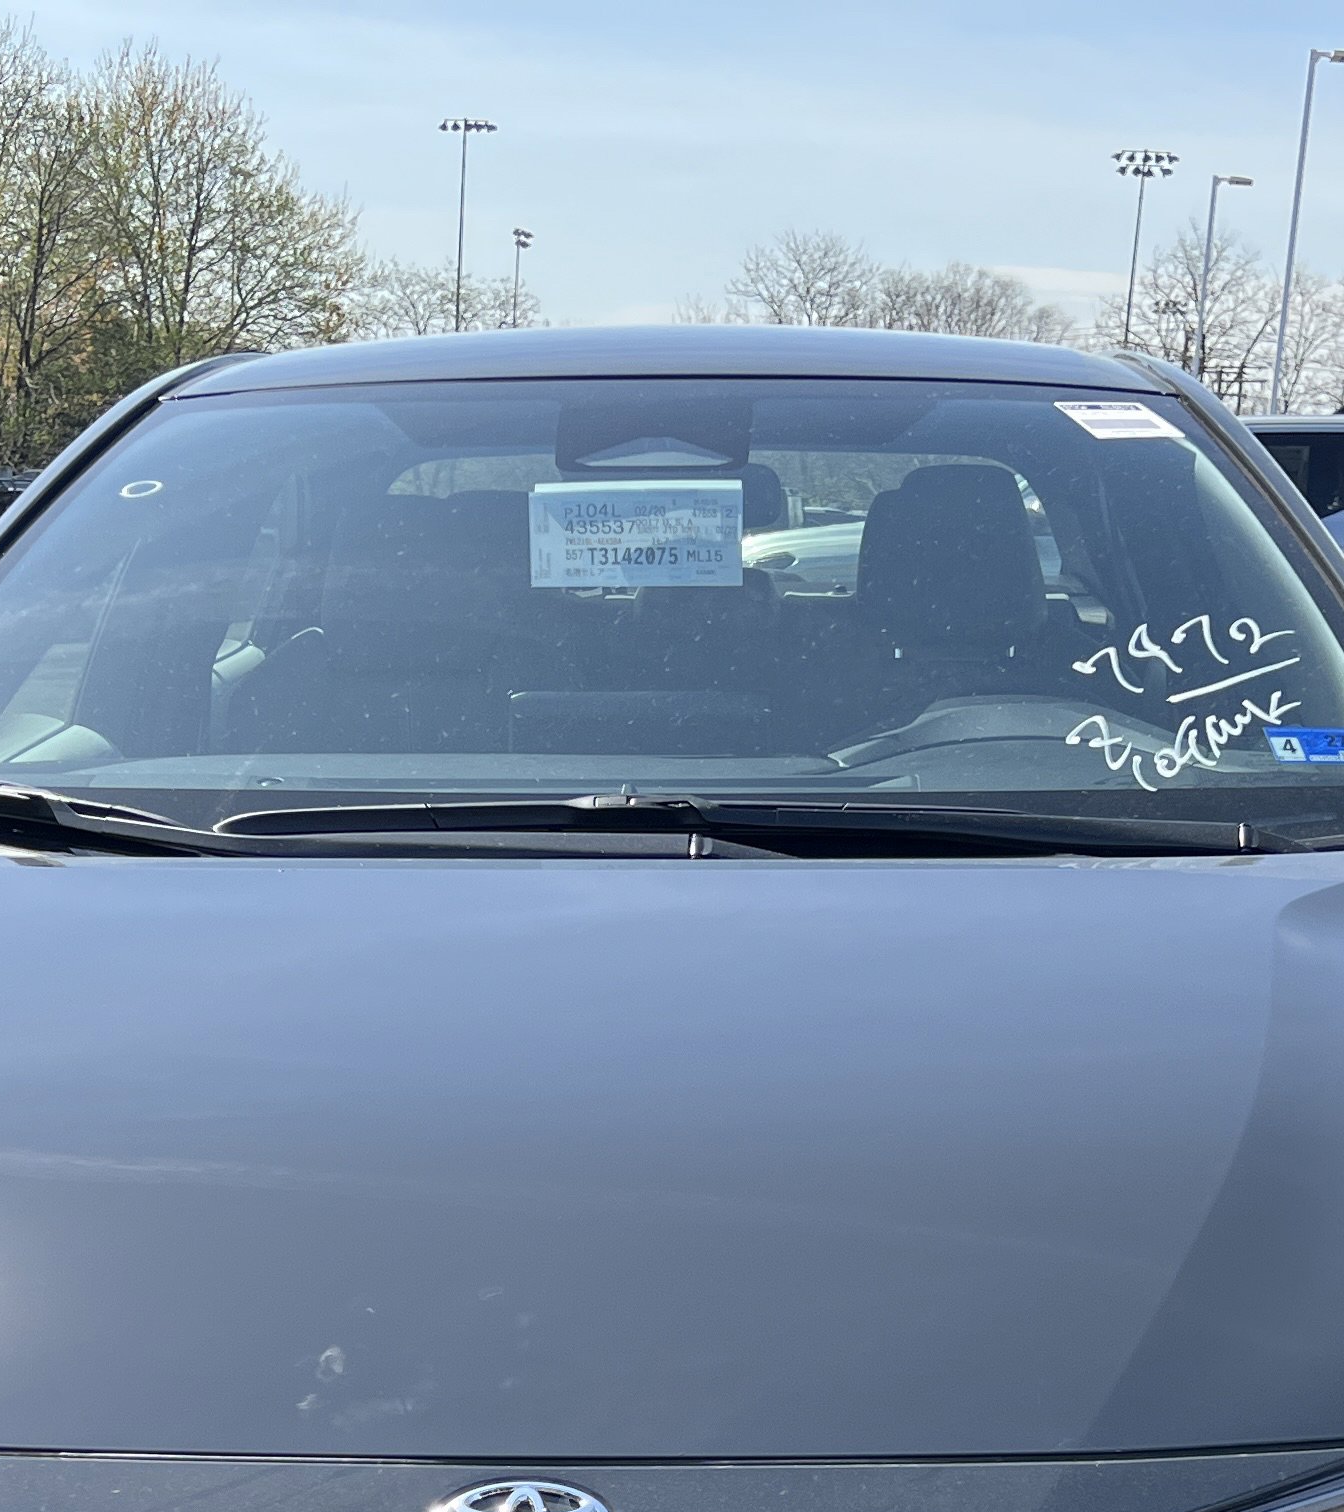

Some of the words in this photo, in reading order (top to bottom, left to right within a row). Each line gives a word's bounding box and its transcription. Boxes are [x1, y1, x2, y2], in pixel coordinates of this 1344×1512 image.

[564, 519, 636, 535] 435537
[587, 547, 679, 566] T3142075
[686, 550, 724, 563] ML15
